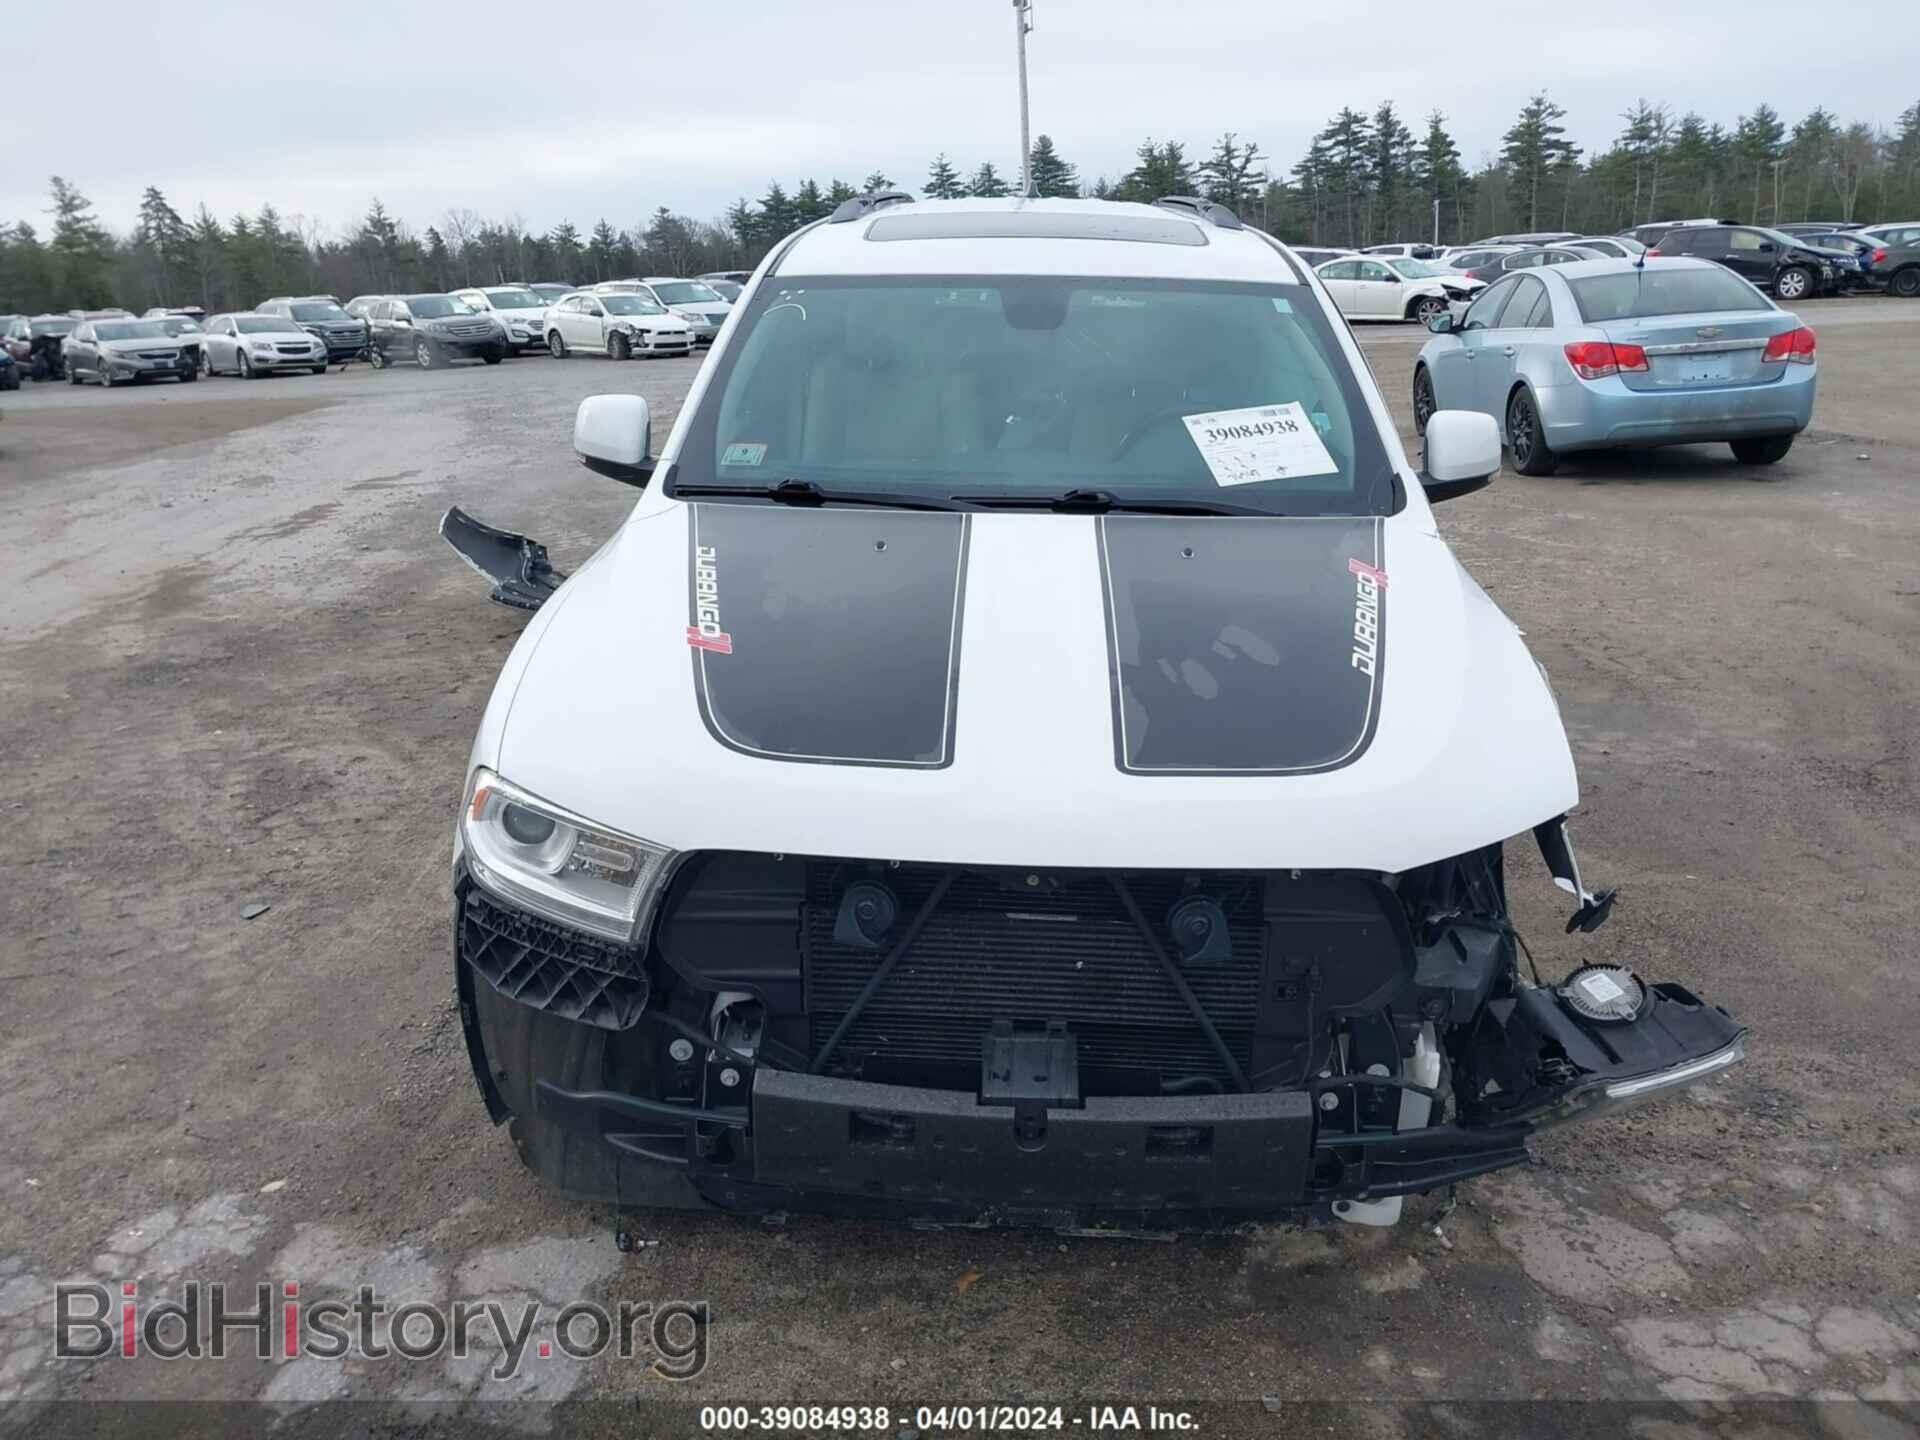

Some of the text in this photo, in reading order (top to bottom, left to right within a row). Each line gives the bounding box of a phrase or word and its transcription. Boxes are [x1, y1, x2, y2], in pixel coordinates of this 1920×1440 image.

[1205, 419, 1299, 443] 39084938
[697, 546, 720, 637] DURANGO
[1352, 571, 1377, 676] DURANGO
